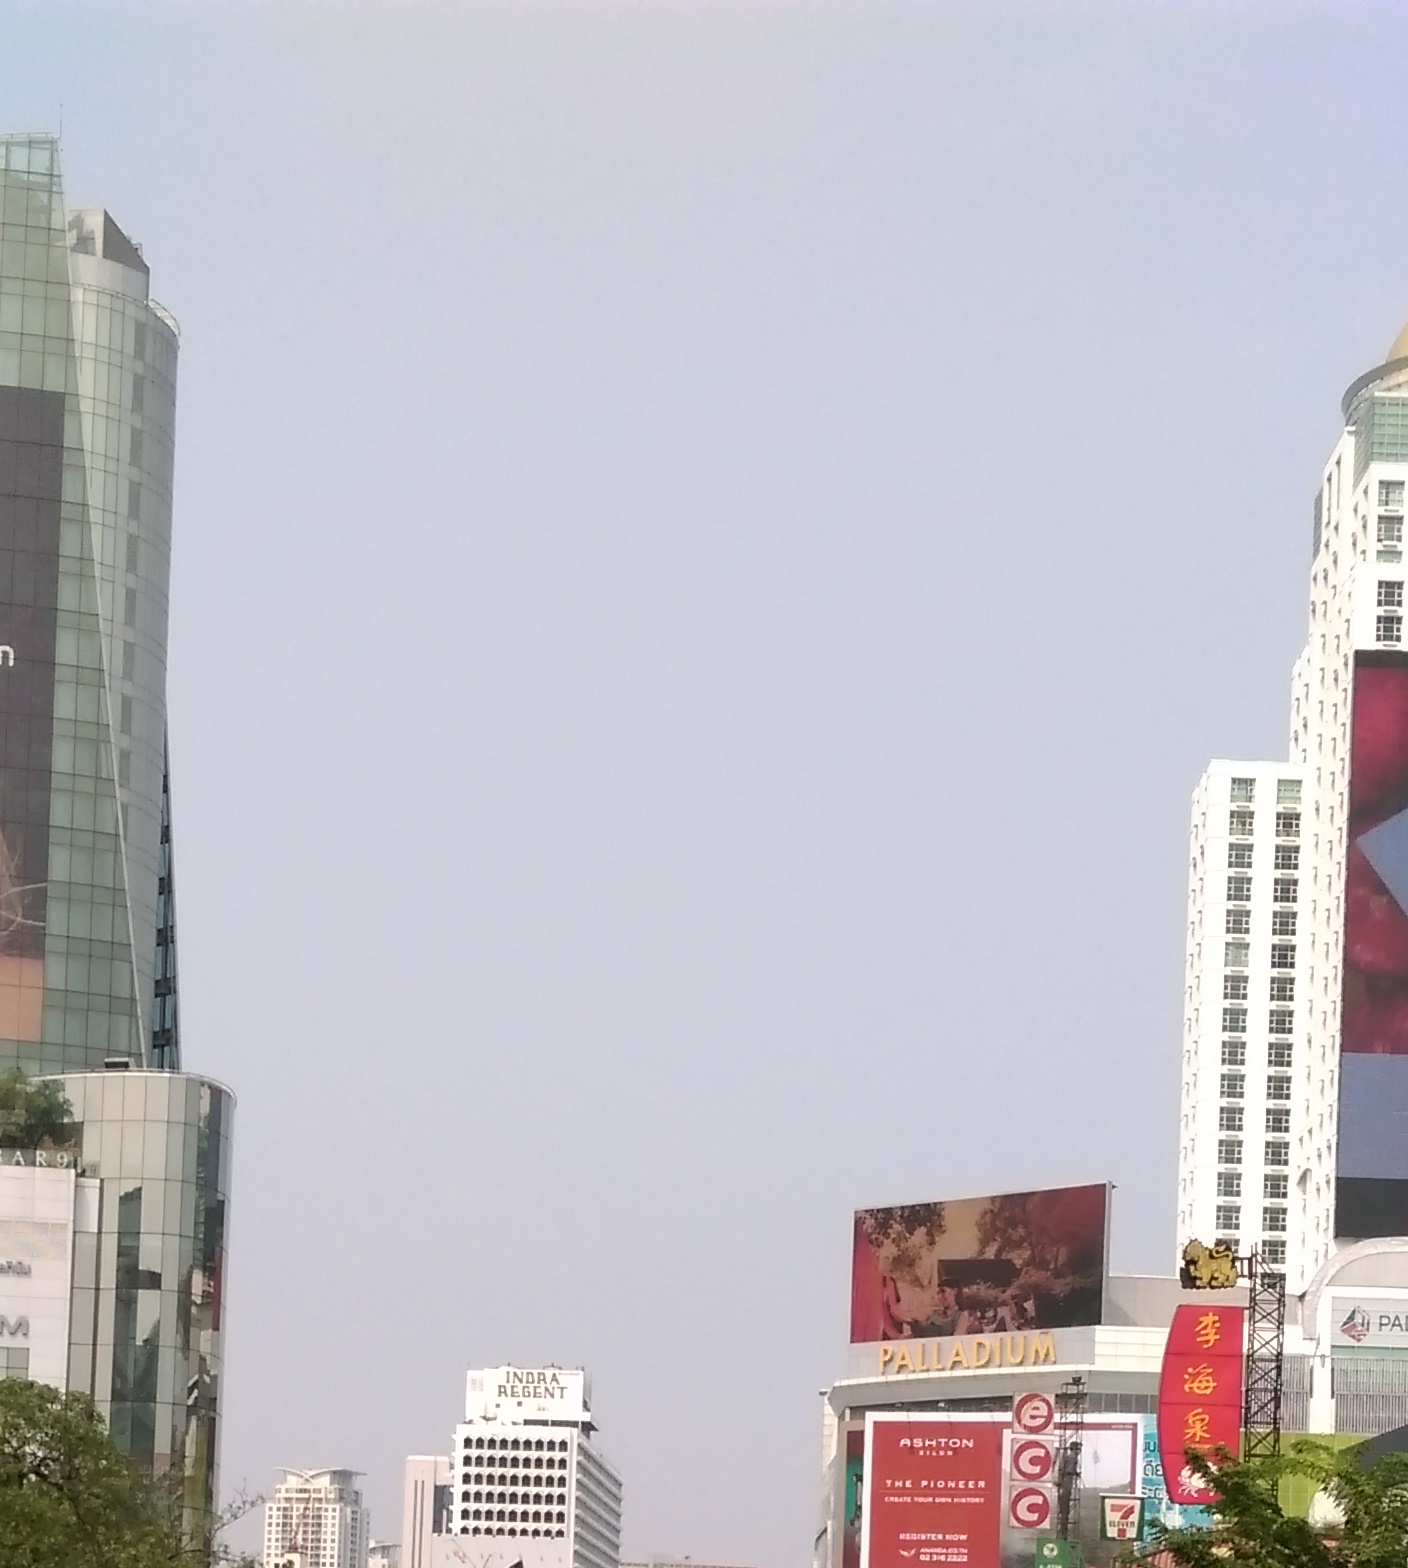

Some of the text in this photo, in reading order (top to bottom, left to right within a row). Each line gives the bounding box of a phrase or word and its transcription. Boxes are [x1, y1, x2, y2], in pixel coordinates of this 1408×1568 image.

[879, 1331, 1057, 1374] PALLADIUM
[505, 1370, 561, 1386] INDRA
[899, 1437, 974, 1449] ASHTON
[885, 1479, 986, 1489] THE PIONEER
